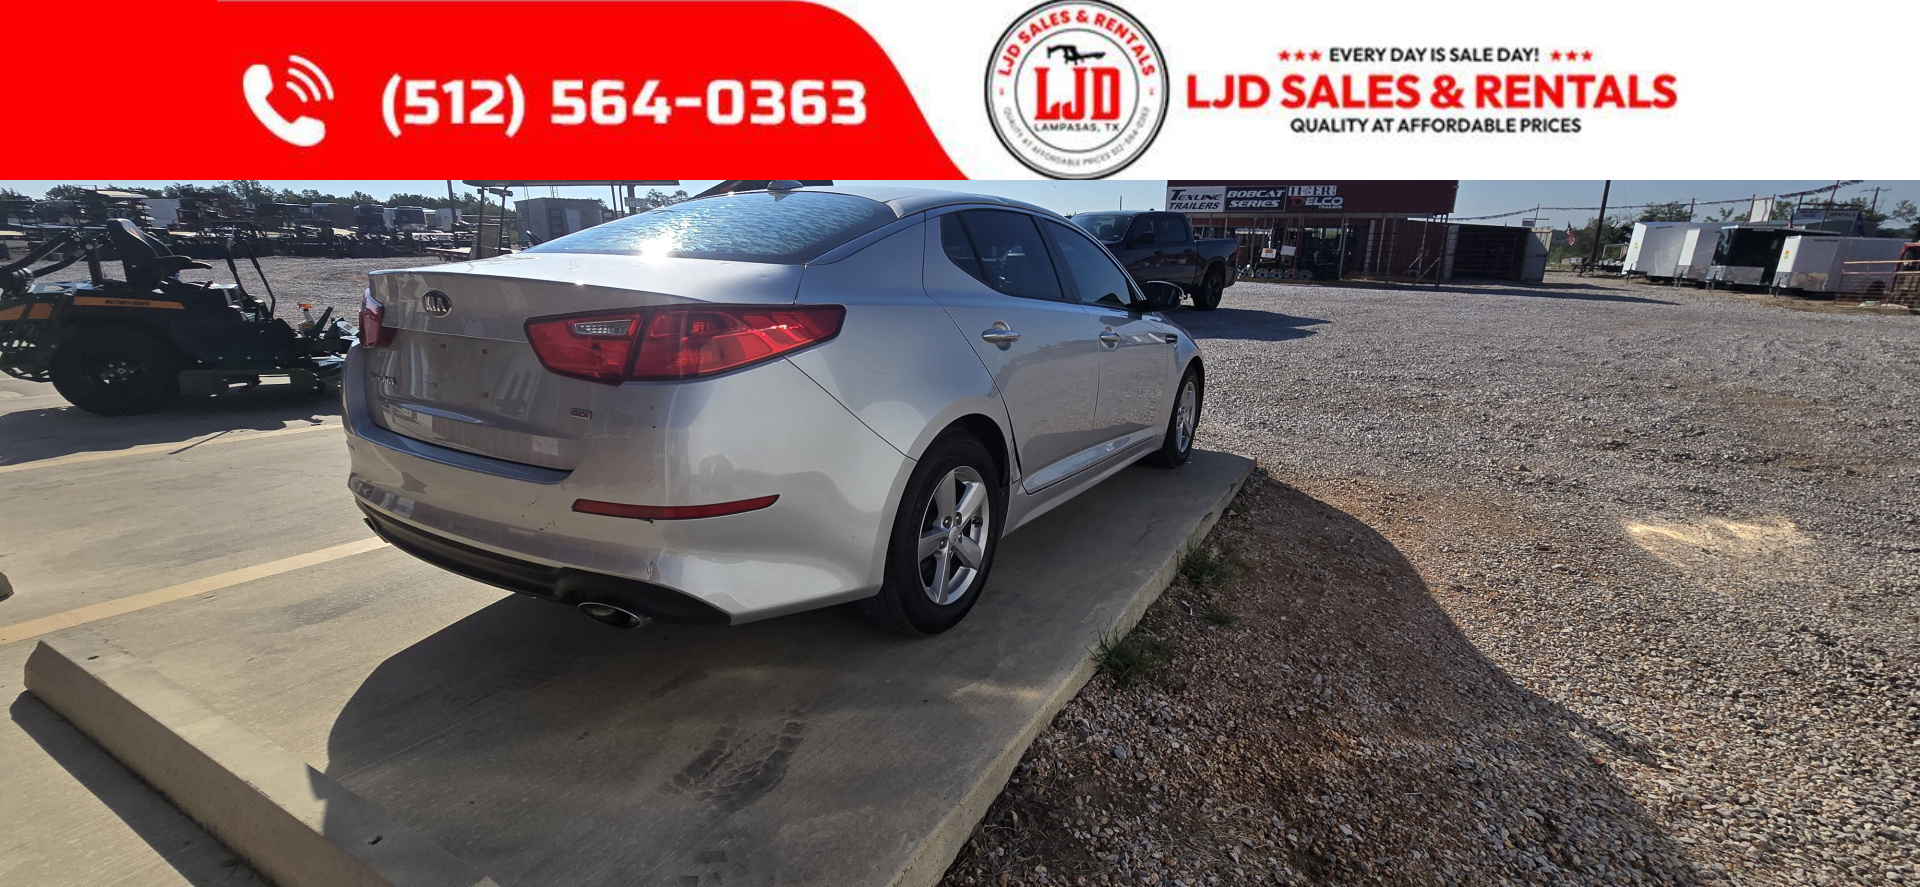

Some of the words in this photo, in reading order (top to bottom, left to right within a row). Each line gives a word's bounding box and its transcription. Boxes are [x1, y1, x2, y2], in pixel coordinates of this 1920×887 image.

[1227, 190, 1286, 198] BOBCAT
[1169, 202, 1221, 210] TRAILERS
[1229, 199, 1281, 208] SERIES
[1290, 196, 1344, 207] DELCO
[425, 295, 448, 312] KIA
[571, 410, 589, 419] GDI
